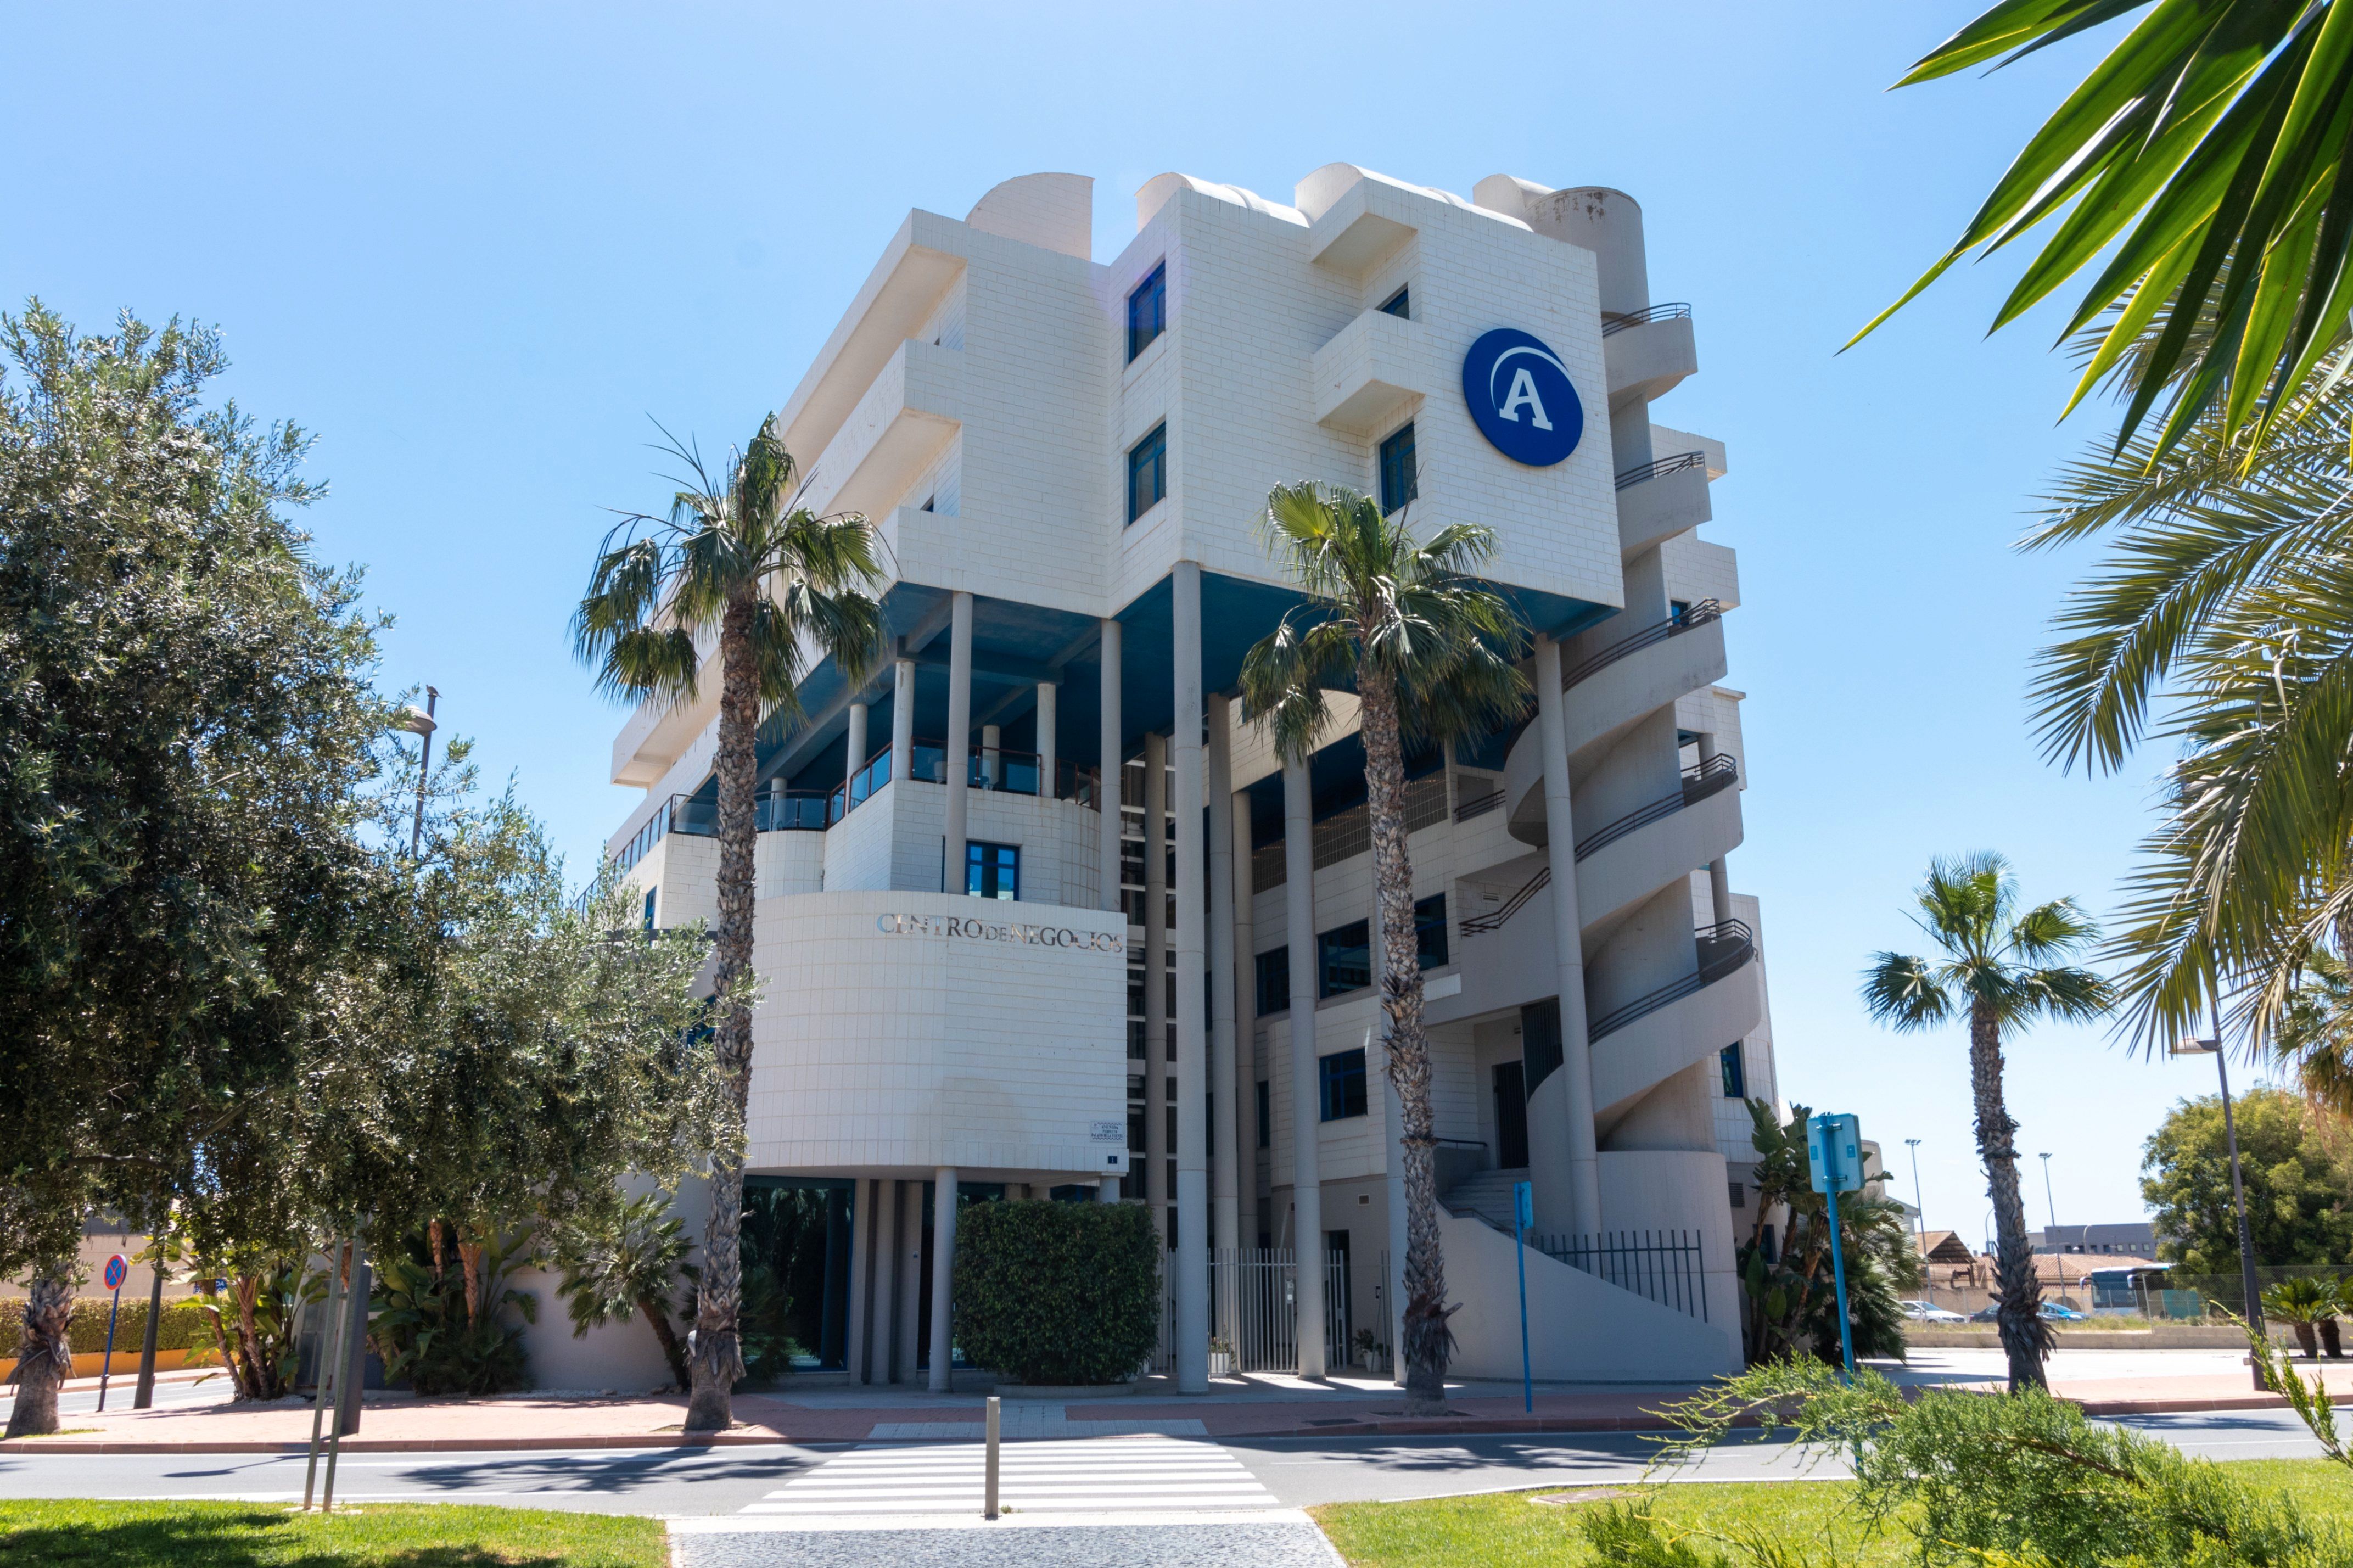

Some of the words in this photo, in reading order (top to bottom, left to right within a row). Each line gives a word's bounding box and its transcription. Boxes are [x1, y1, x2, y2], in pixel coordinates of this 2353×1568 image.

[877, 912, 983, 938] CENTRO
[984, 925, 1007, 942] DE
[1009, 922, 1123, 953] NEGOCIOS
